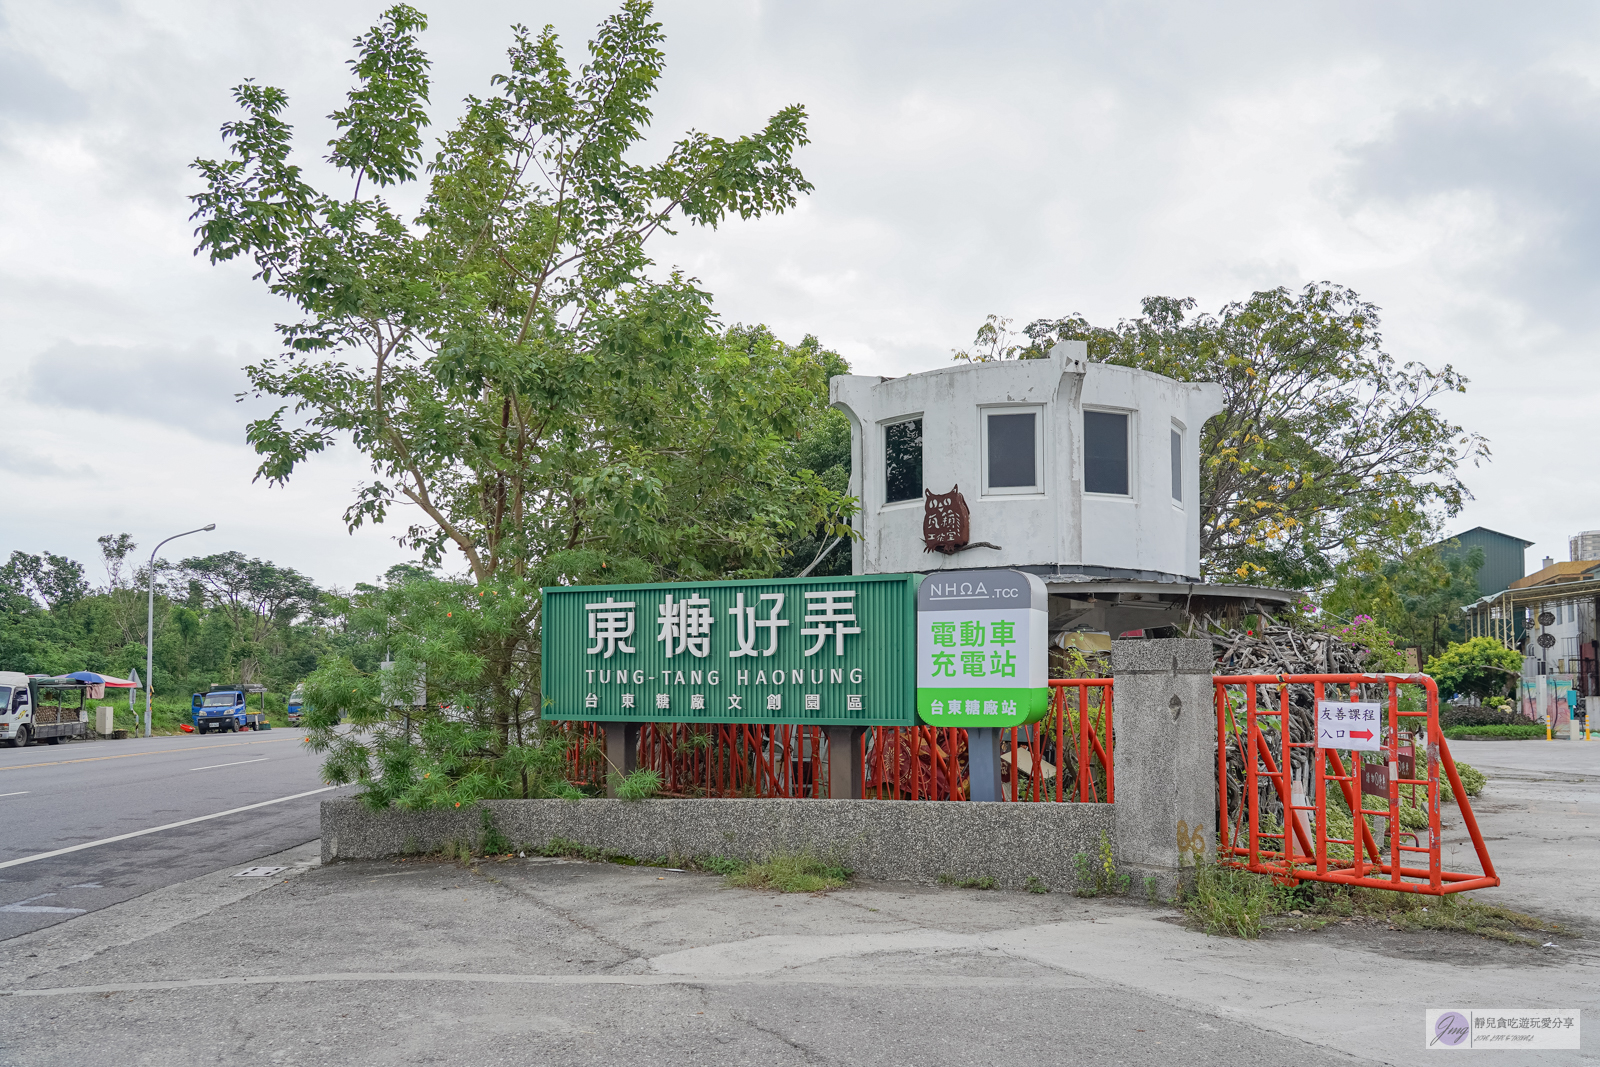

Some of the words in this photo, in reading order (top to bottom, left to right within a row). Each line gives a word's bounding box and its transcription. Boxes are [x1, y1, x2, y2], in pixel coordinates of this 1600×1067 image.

[585, 590, 862, 659] 東糖好弄
[930, 619, 1017, 648] 電動車
[930, 649, 1017, 678] 充電站
[737, 667, 863, 686] HAONUNG
[585, 693, 863, 711] 台東糖廠文創園區
[930, 699, 1017, 716] 台東糖廠站
[1320, 707, 1376, 722] 友善課程
[1320, 729, 1346, 740] 入口
